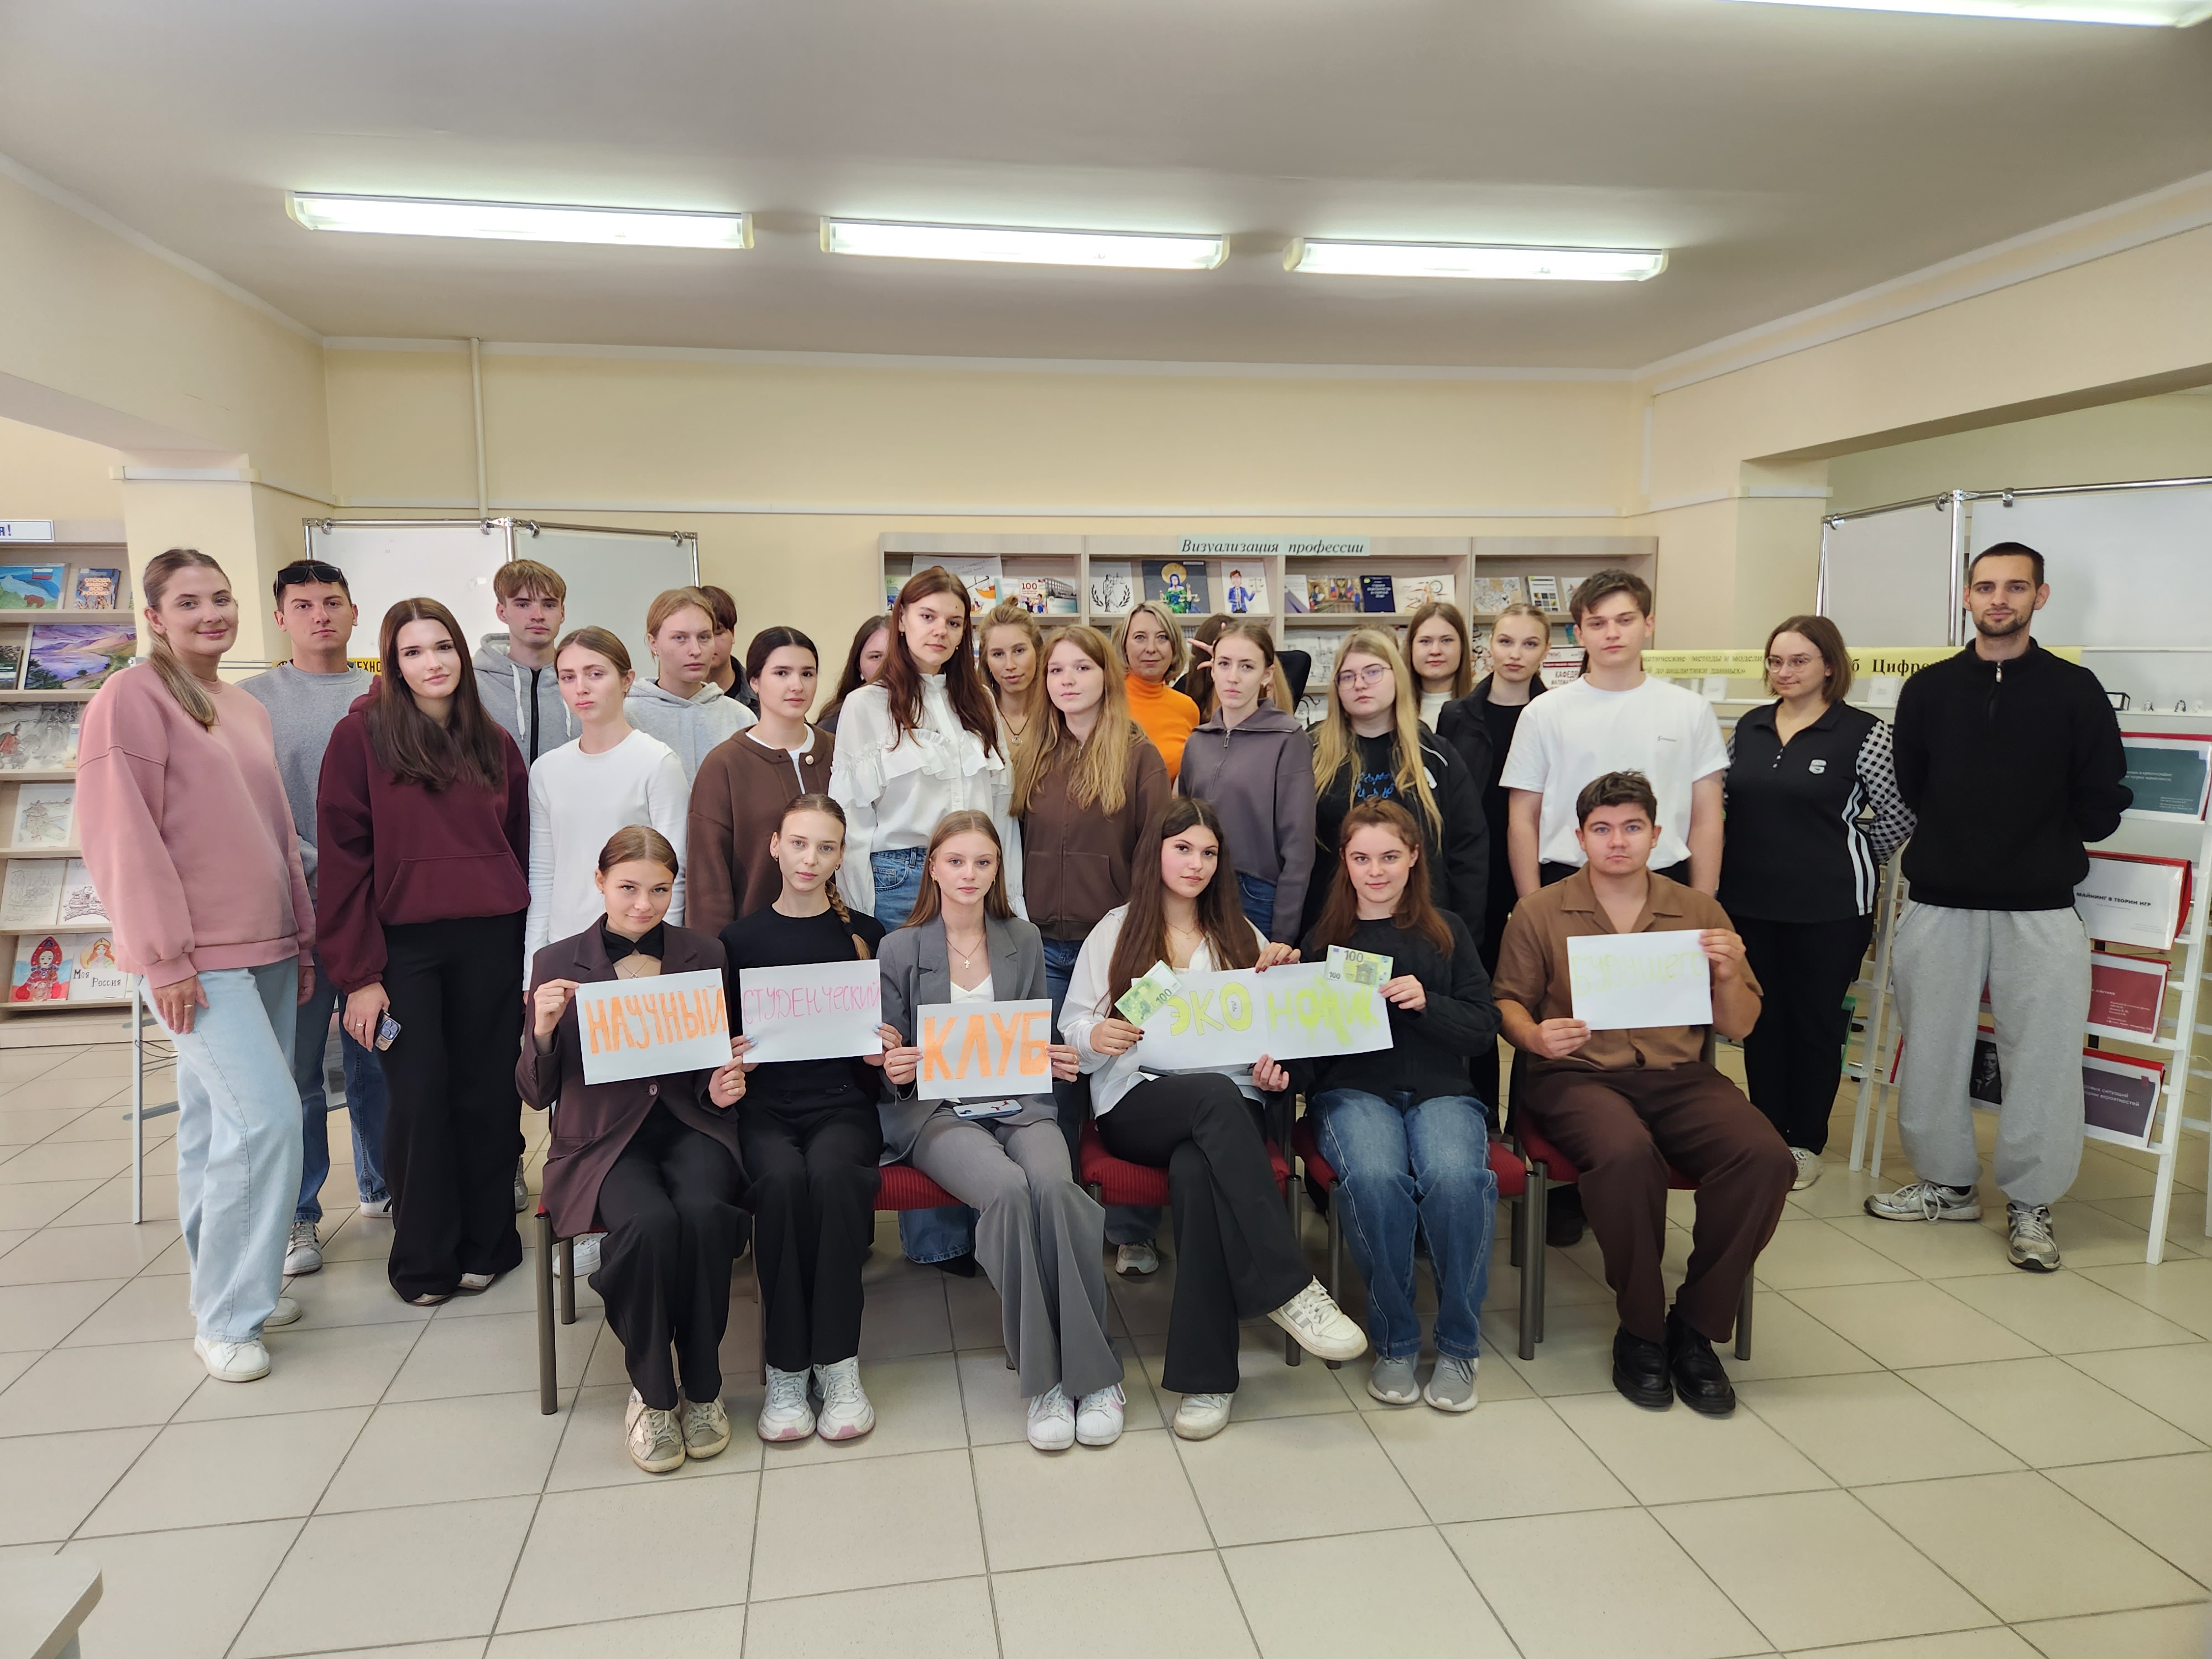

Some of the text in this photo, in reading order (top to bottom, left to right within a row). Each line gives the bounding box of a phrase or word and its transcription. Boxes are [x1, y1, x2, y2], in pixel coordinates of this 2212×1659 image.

[1182, 539, 1364, 554] Визуализация профессии
[2076, 892, 2107, 900] МАЙНИНГ
[1344, 950, 1364, 963] 100
[73, 969, 90, 979] Моя
[92, 977, 121, 987] Россия
[1156, 988, 1172, 1004] 100
[585, 984, 728, 1055] НАУЧНЫЙ
[923, 1010, 1052, 1082] КЛУБ
